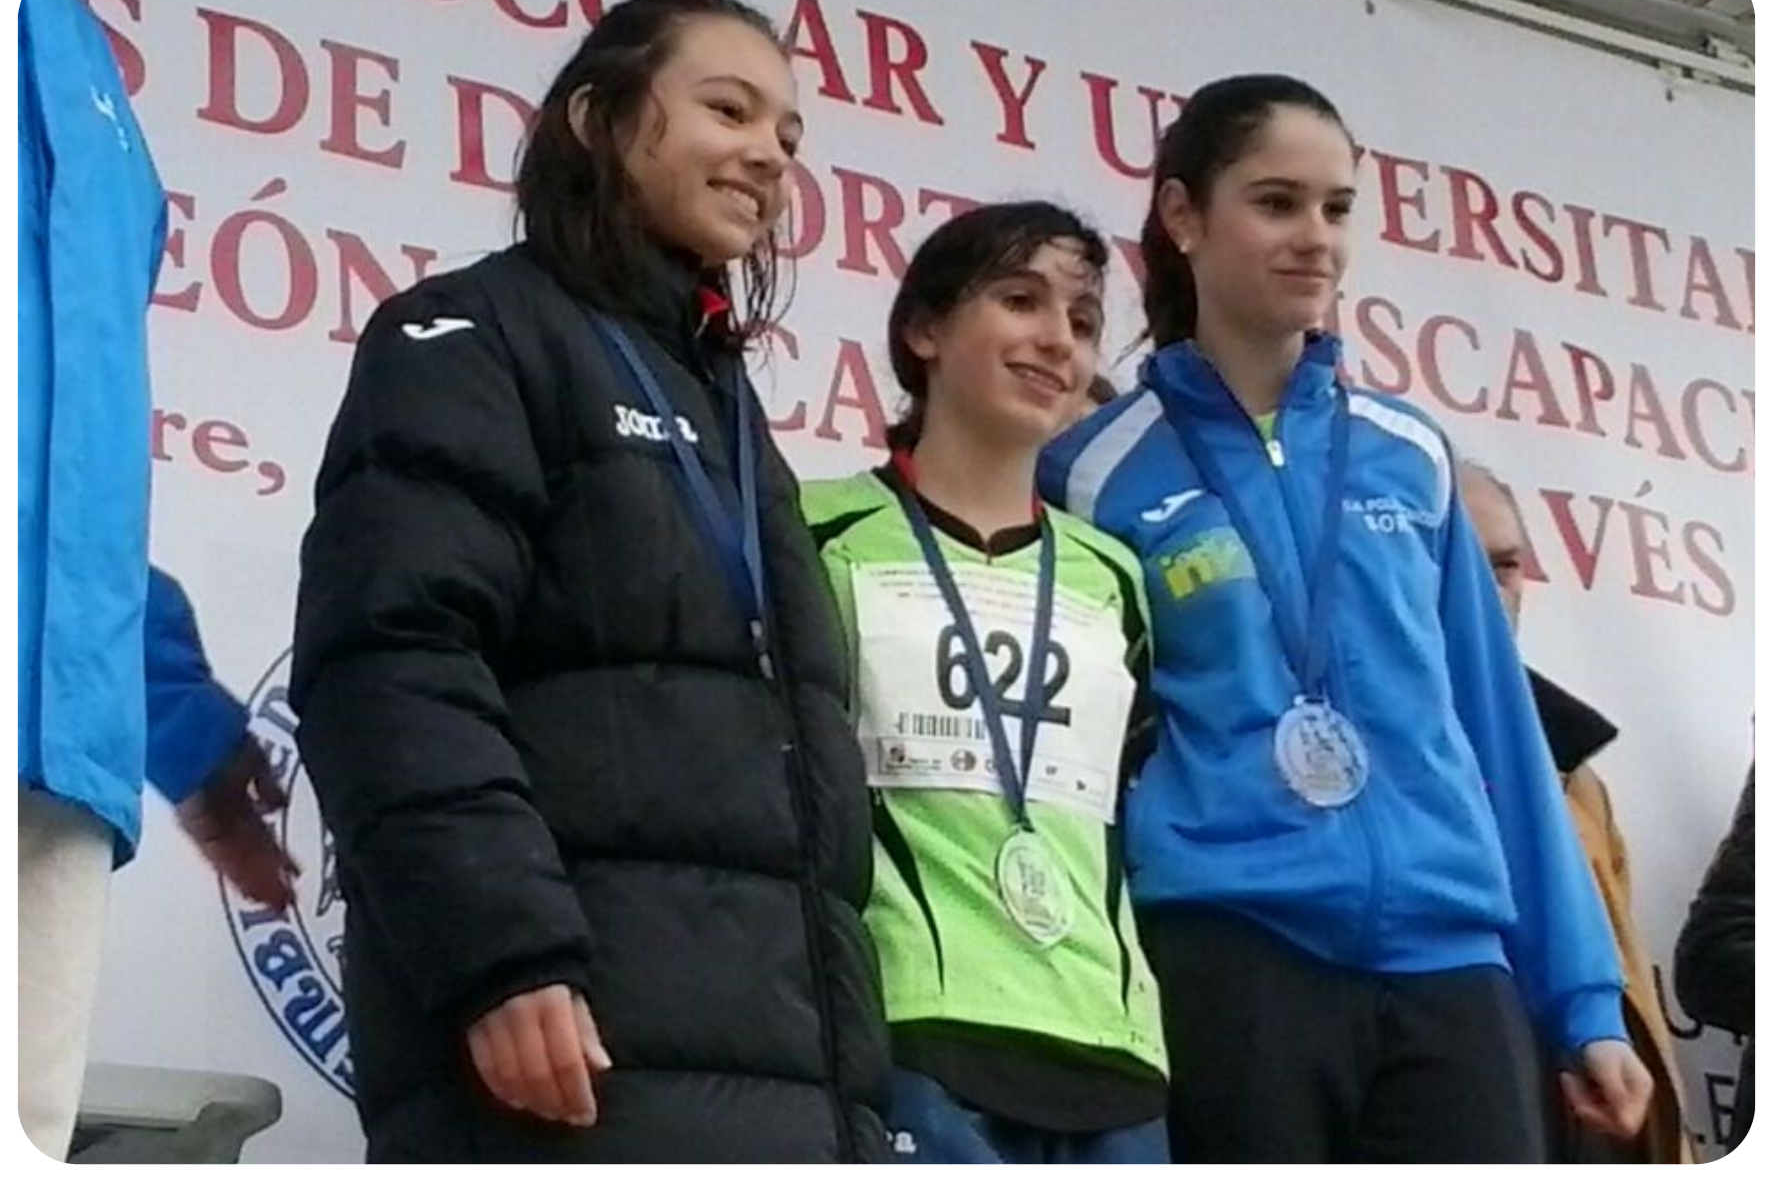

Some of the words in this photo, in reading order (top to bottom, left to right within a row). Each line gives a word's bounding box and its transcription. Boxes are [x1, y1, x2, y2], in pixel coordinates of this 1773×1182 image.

[197, 6, 407, 170] DE
[970, 39, 1047, 151] Y
[150, 177, 438, 344] EÓN
[152, 407, 286, 496] re,
[937, 623, 1071, 727] 622
